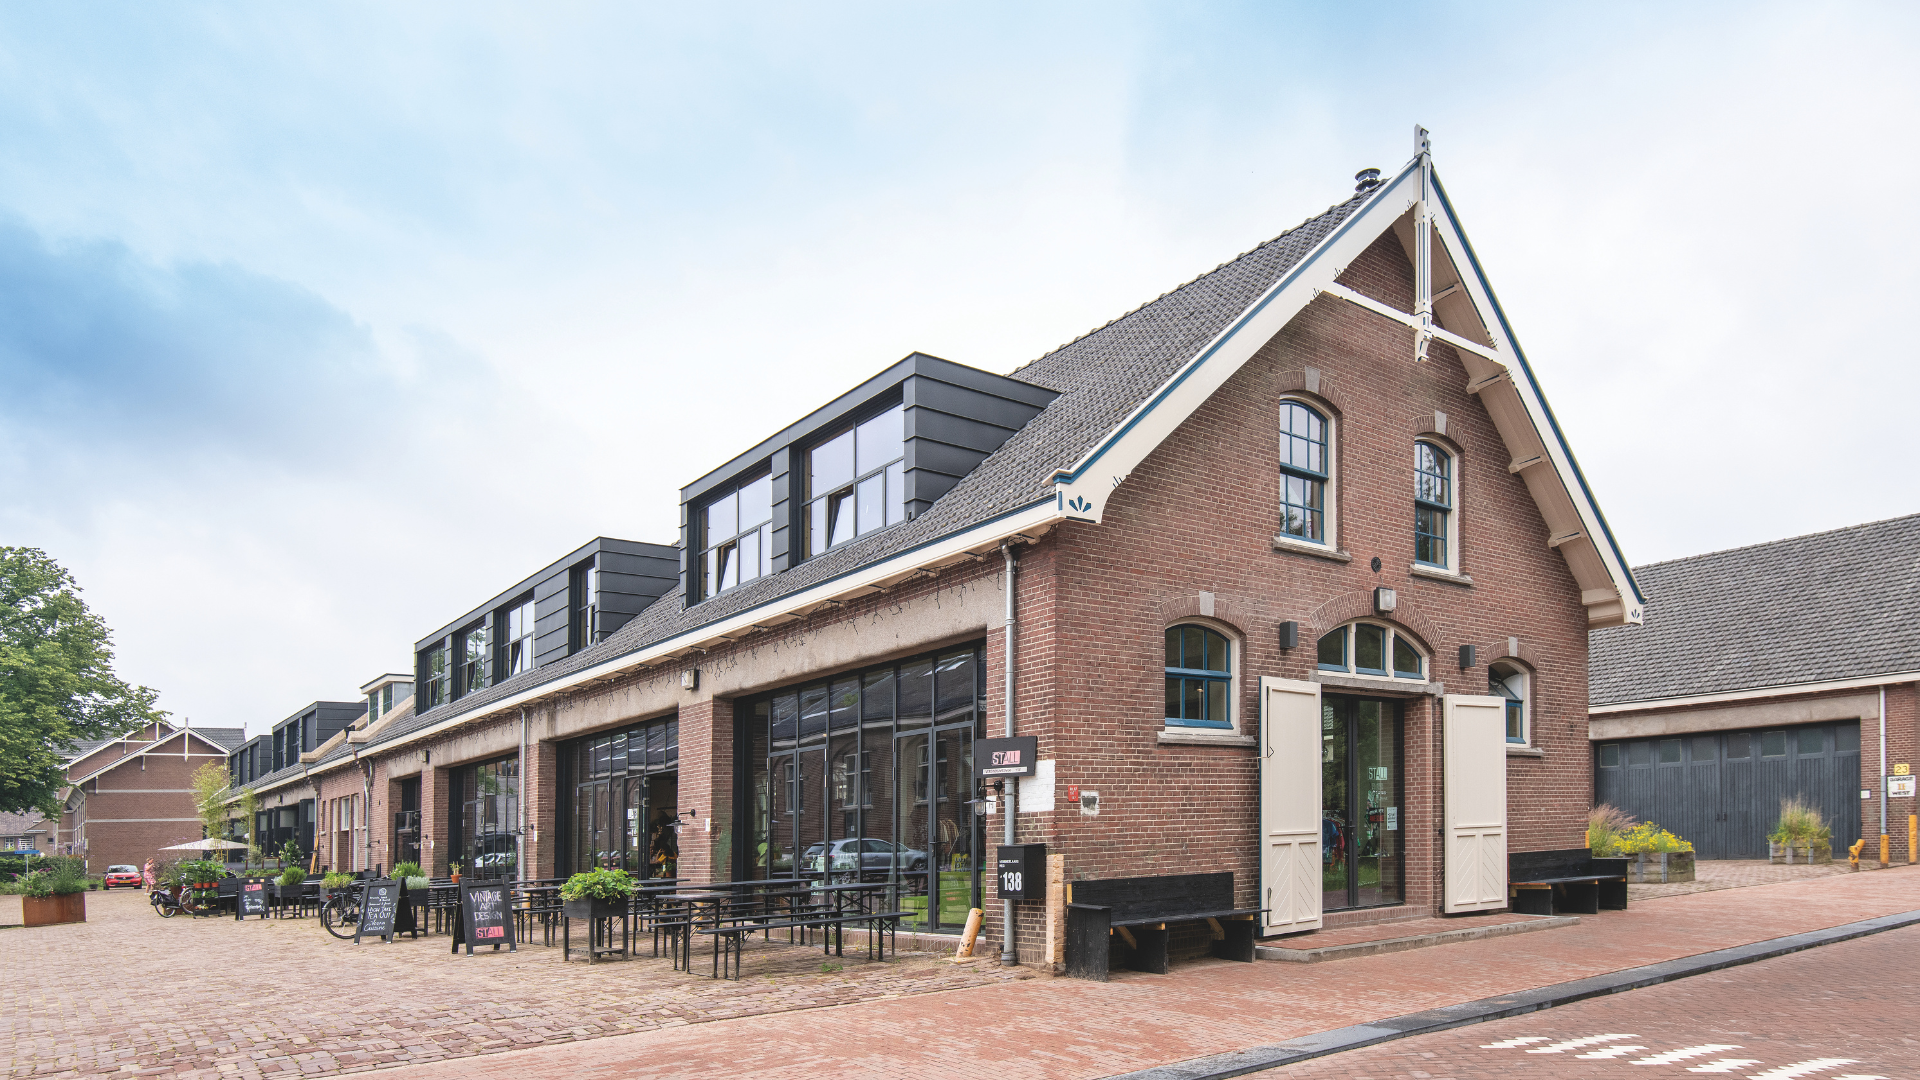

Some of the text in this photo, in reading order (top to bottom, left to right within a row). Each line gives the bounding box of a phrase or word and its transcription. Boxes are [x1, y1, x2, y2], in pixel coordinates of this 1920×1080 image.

[992, 751, 1019, 765] STALL
[1368, 767, 1387, 780] STALL
[1895, 765, 1908, 774] 23
[1002, 871, 1022, 891] 138
[469, 890, 502, 902] VINTAGE
[480, 902, 497, 911] ART
[474, 911, 503, 920] DESIGN
[476, 927, 503, 938] STALL
